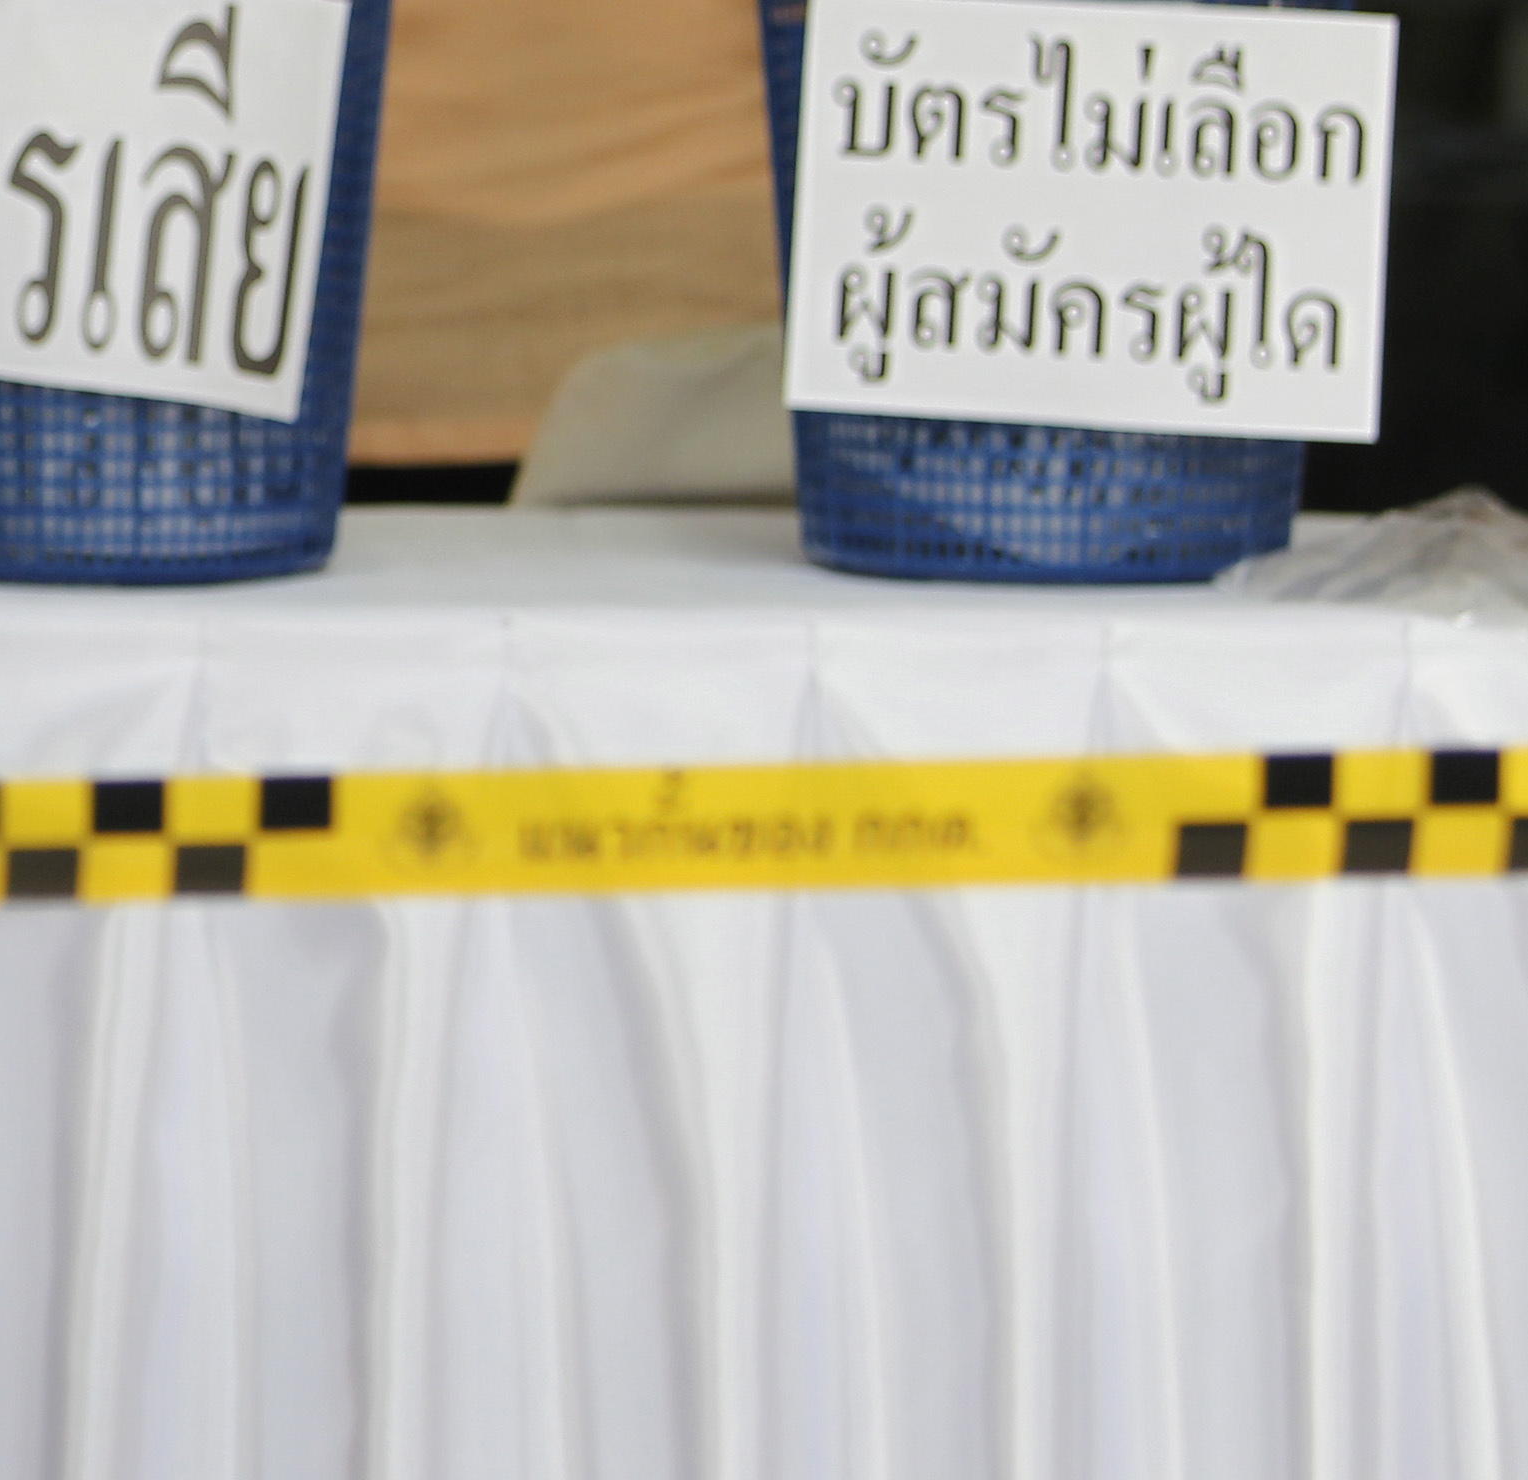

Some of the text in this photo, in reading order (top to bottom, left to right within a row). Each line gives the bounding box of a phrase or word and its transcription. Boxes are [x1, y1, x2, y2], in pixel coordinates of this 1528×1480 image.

[833, 30, 1366, 184] บัตรไม่เลือก
[833, 206, 1342, 404] ผู้สมัครผู้ใด
